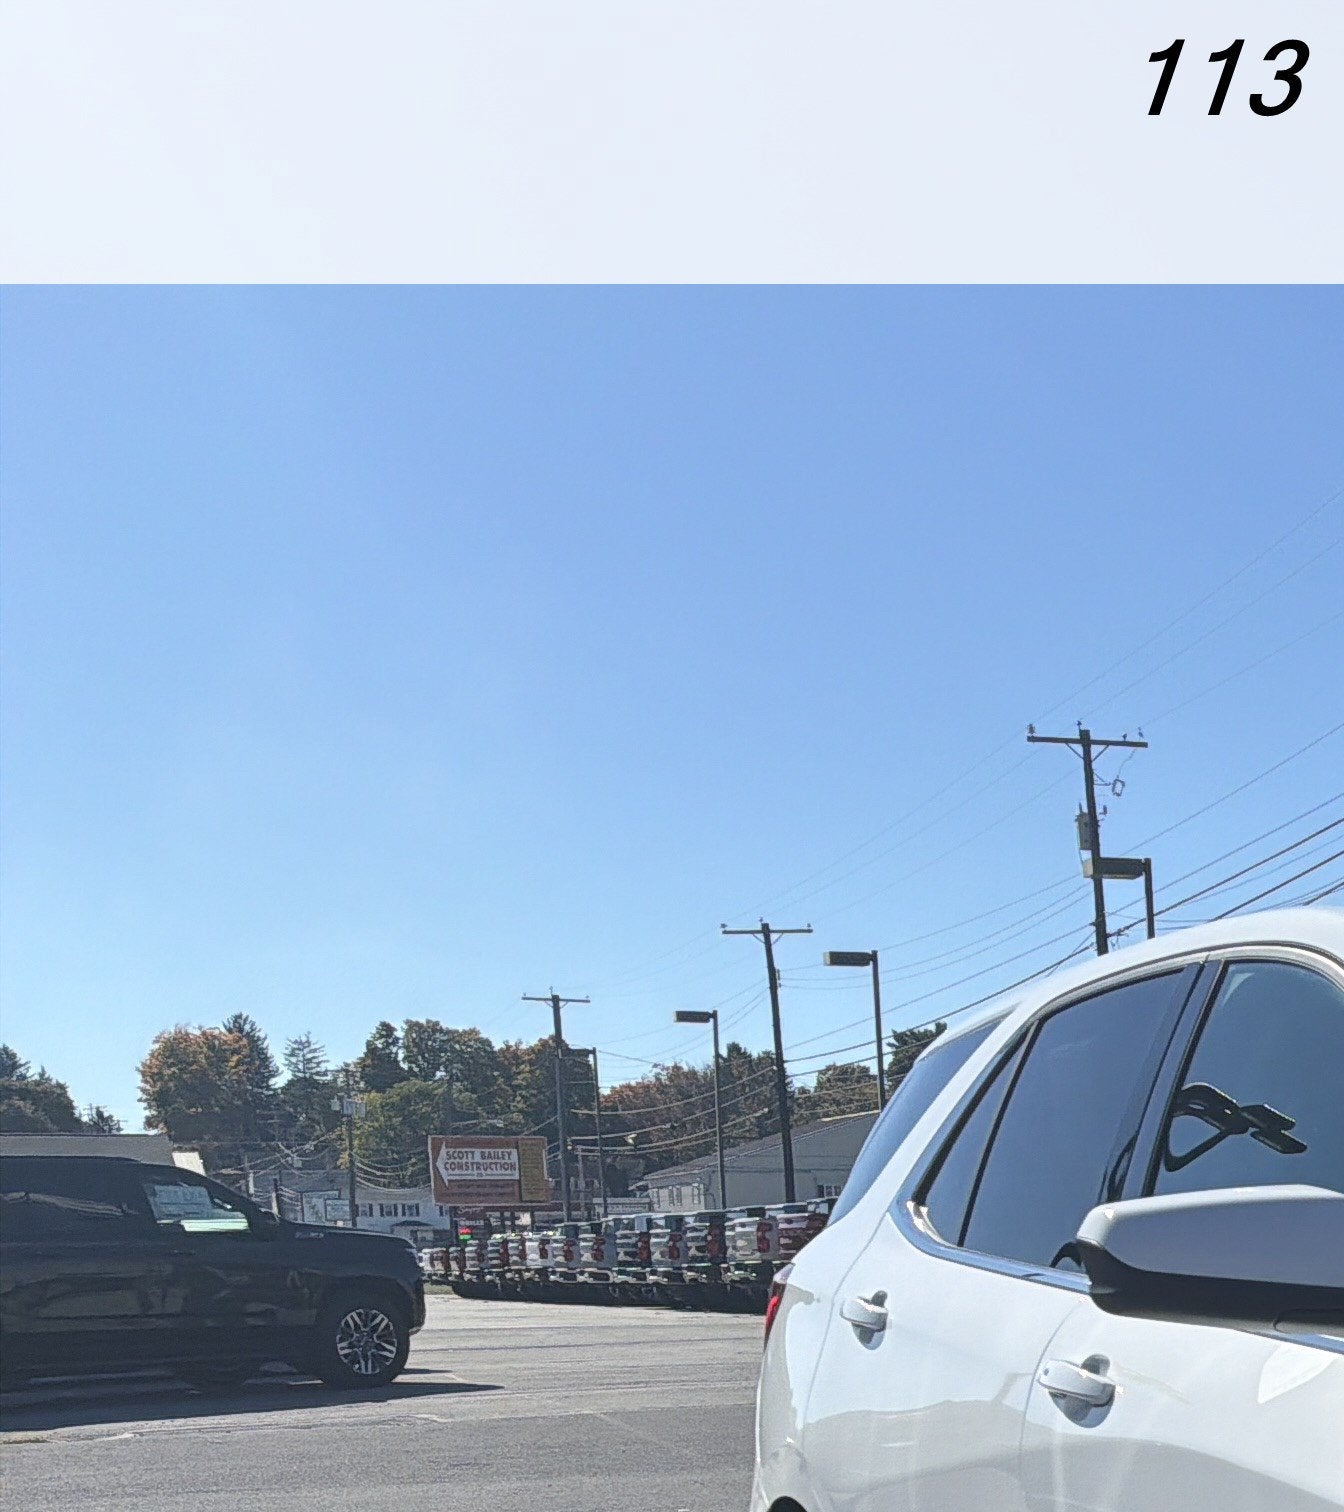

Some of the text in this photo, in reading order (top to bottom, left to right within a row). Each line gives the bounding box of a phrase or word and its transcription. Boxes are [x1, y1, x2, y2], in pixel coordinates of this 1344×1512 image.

[446, 1150, 512, 1161] SCOTT BAILEY
[444, 1161, 517, 1172] CONSTRUCTION
